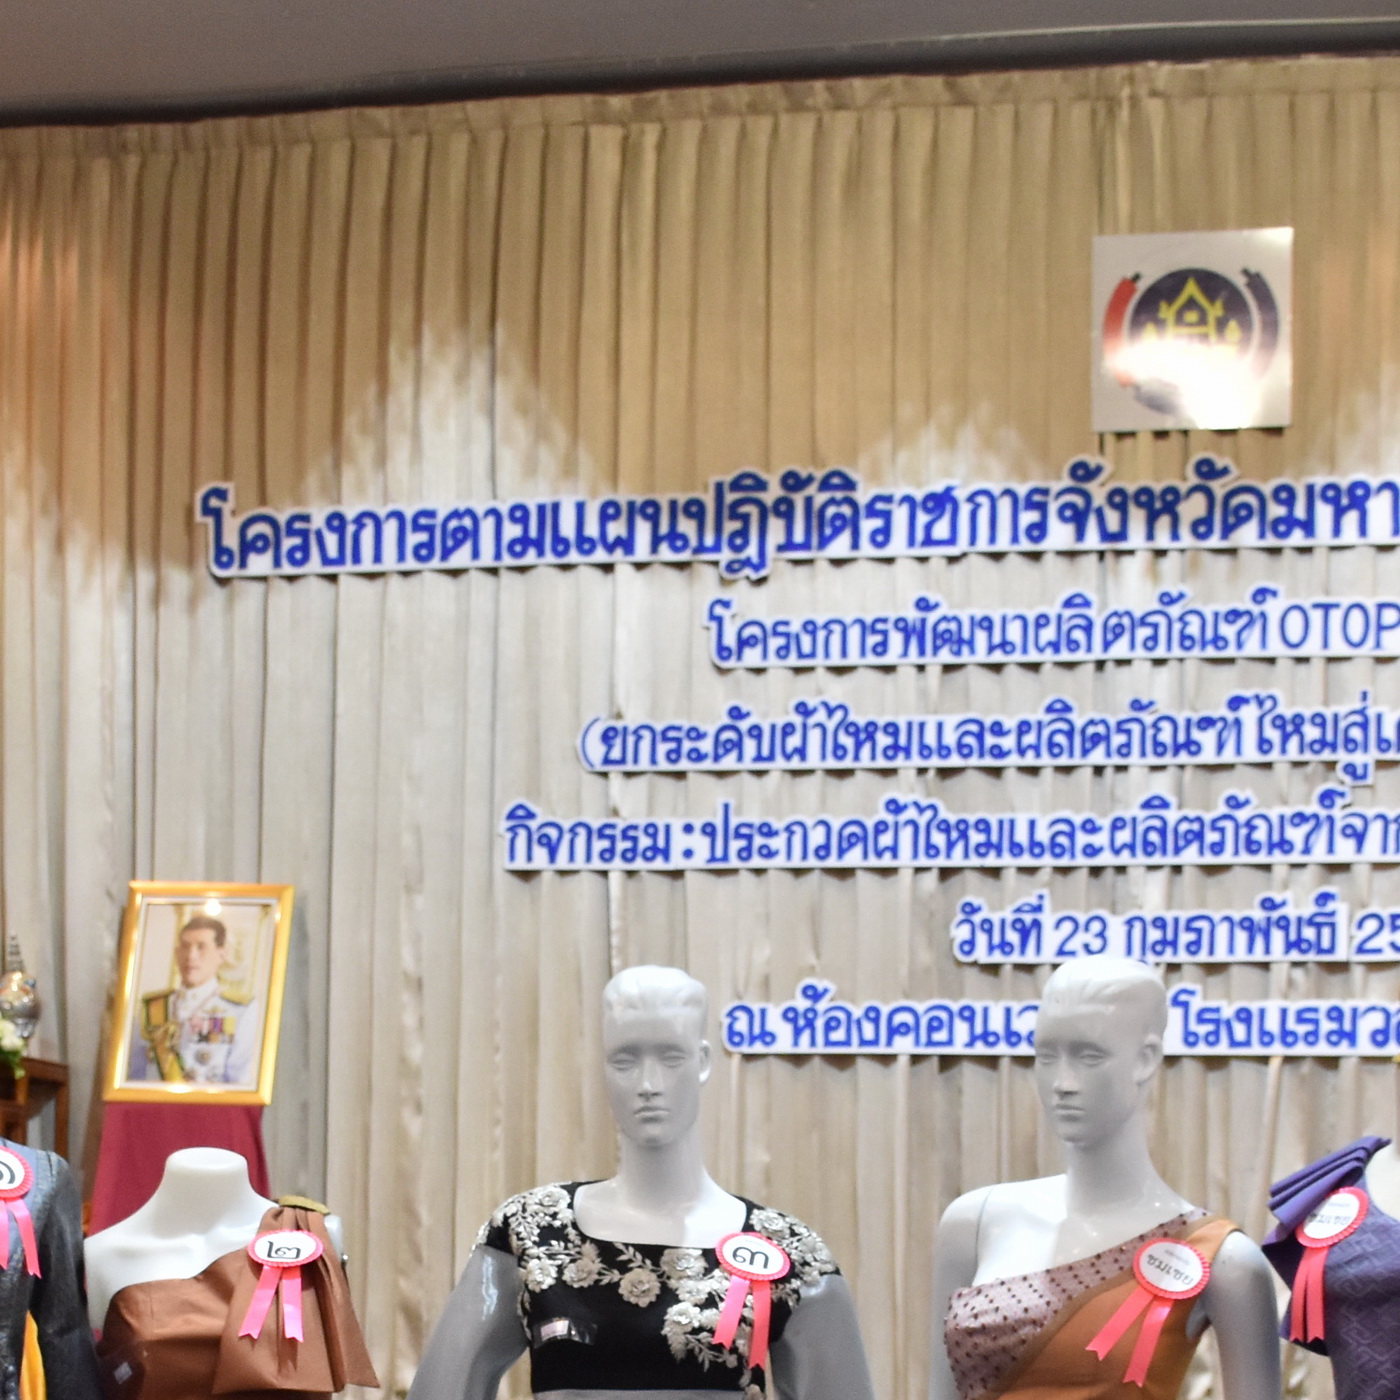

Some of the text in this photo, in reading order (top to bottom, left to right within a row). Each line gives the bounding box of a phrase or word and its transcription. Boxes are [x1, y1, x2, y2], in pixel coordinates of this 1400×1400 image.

[1053, 914, 1110, 957] 23
[266, 1240, 302, 1260] ๒
[732, 1246, 770, 1269] ๓
